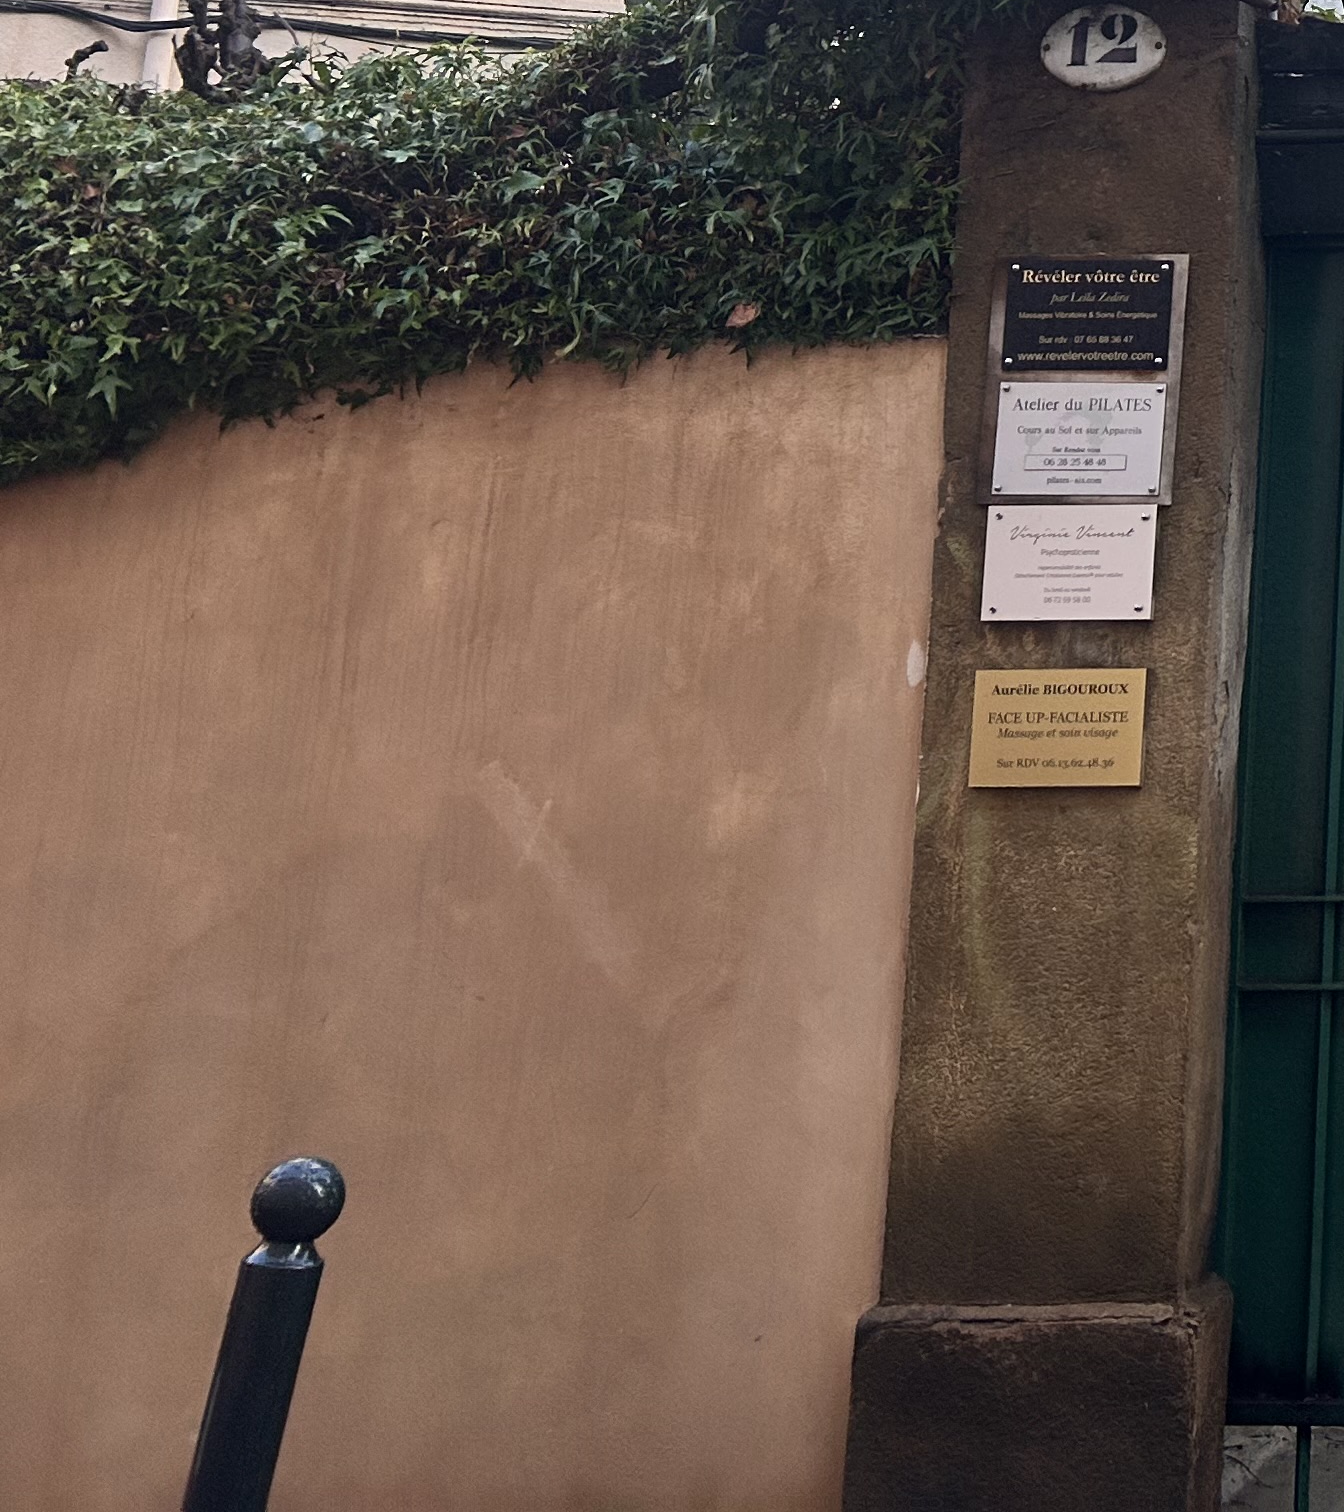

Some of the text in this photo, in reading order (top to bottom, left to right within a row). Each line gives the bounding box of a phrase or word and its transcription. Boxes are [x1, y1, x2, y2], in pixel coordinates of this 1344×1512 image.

[1066, 15, 1138, 67] 12
[1022, 269, 1161, 284] Révéler vôtre être
[1050, 293, 1069, 305] par
[1074, 335, 1084, 344] 07
[1122, 335, 1134, 344] 47
[1012, 398, 1152, 412] Atelier du PILATES
[1017, 425, 1142, 436] Cours au Sol et sur Appareils
[1043, 458, 1056, 467] 06
[992, 683, 1129, 695] Aurélie BIGOUROUX
[988, 711, 1129, 724] FACE UP-FACIALISTE
[997, 727, 1118, 739] Massage et soin visage
[997, 758, 1014, 768] Sur
[1016, 758, 1040, 768] RDV
